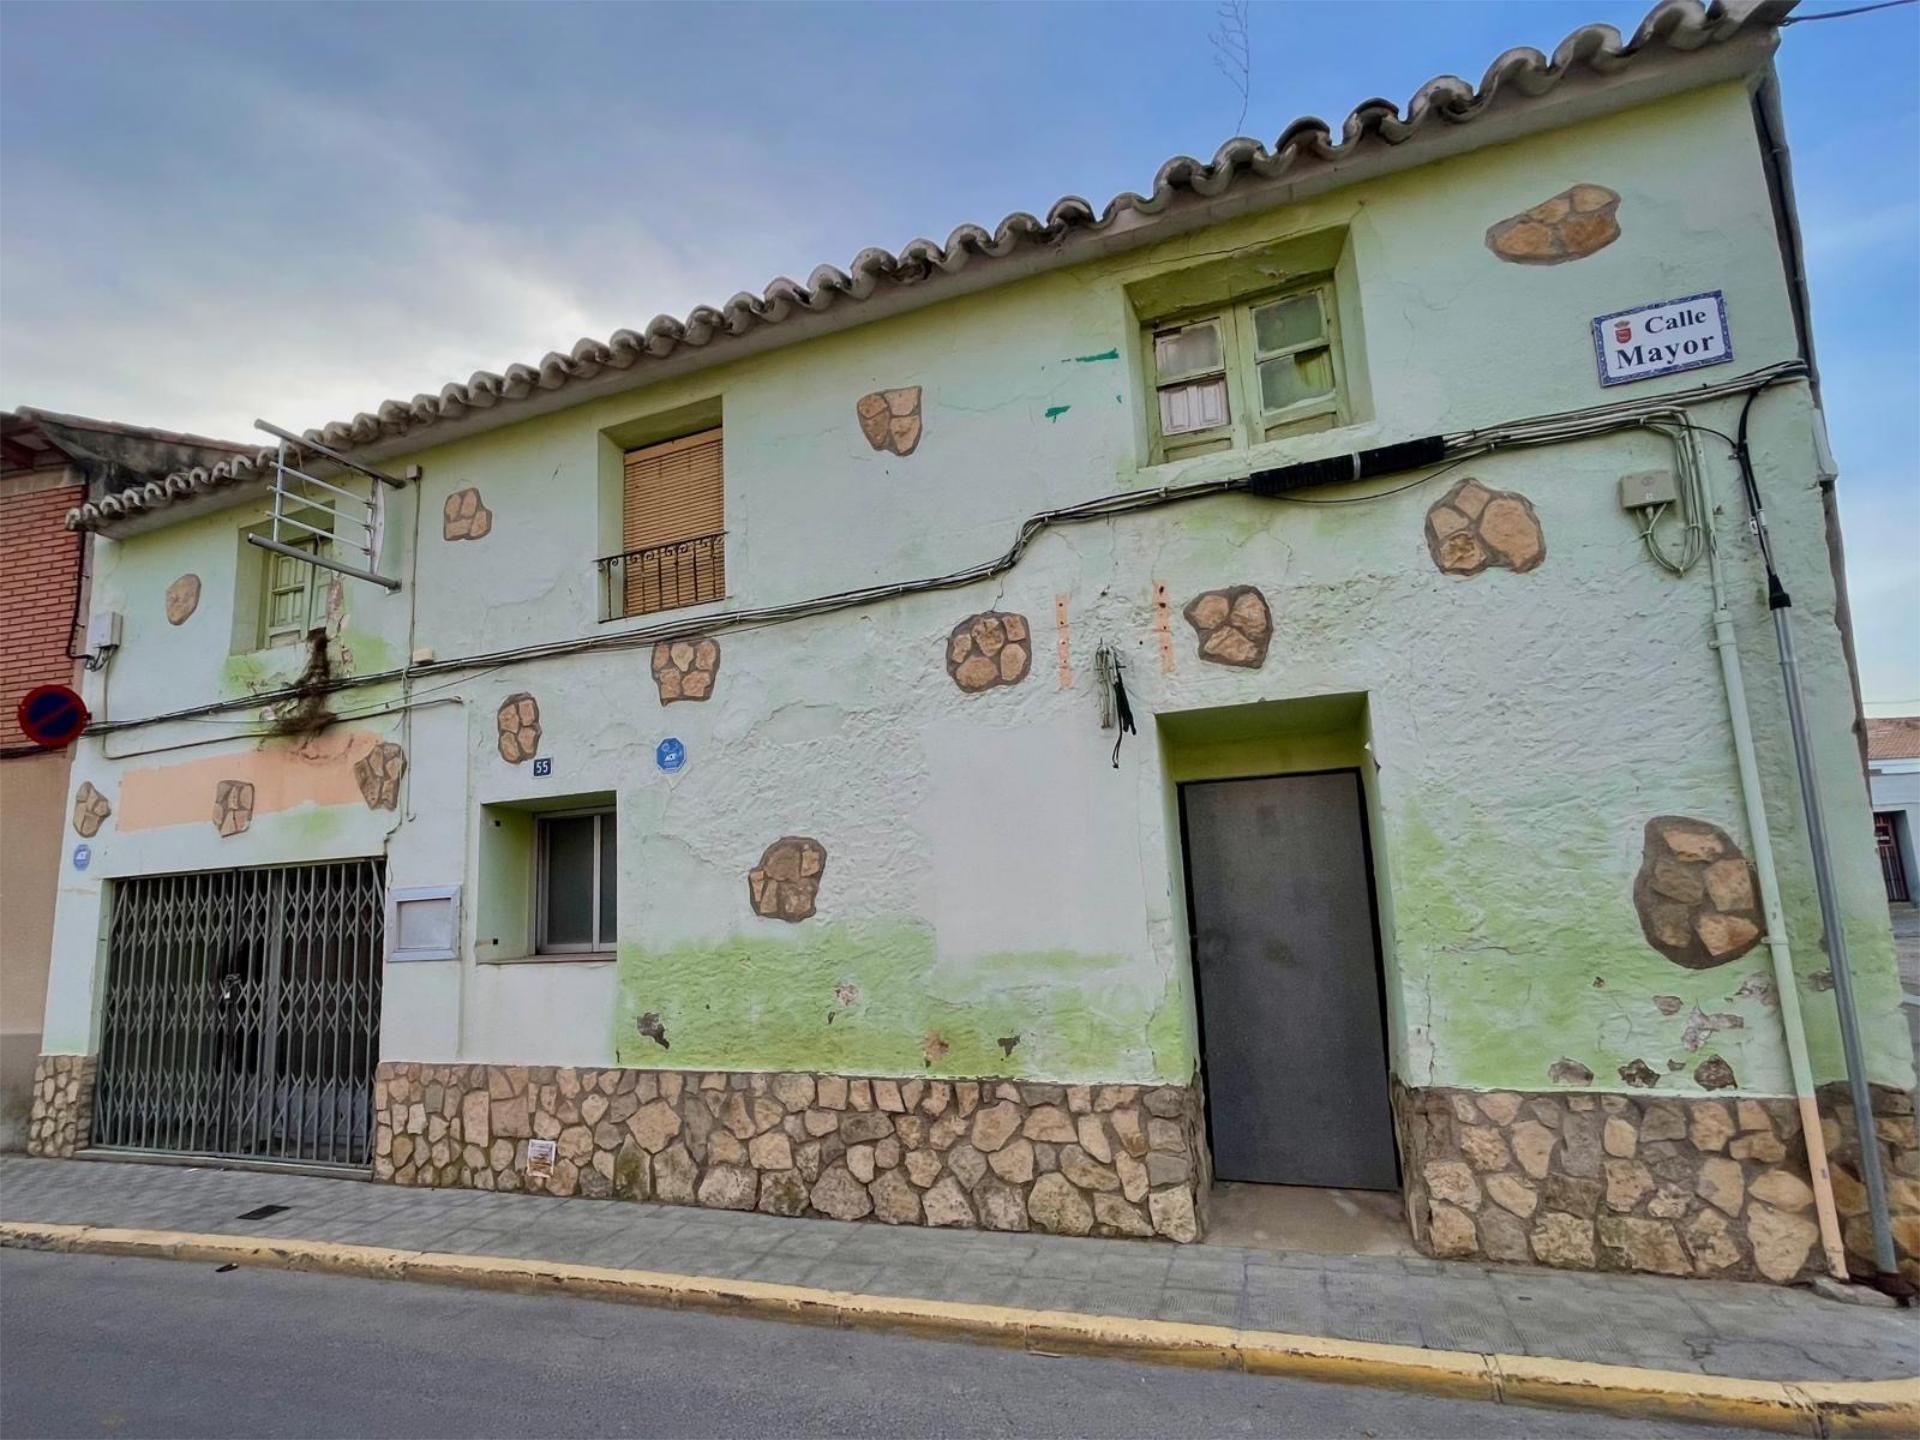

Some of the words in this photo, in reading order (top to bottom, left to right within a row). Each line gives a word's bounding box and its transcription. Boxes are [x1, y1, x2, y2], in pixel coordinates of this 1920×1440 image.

[1645, 310, 1706, 334] Calle
[1616, 335, 1714, 369] Mayor
[536, 760, 548, 774] 55
